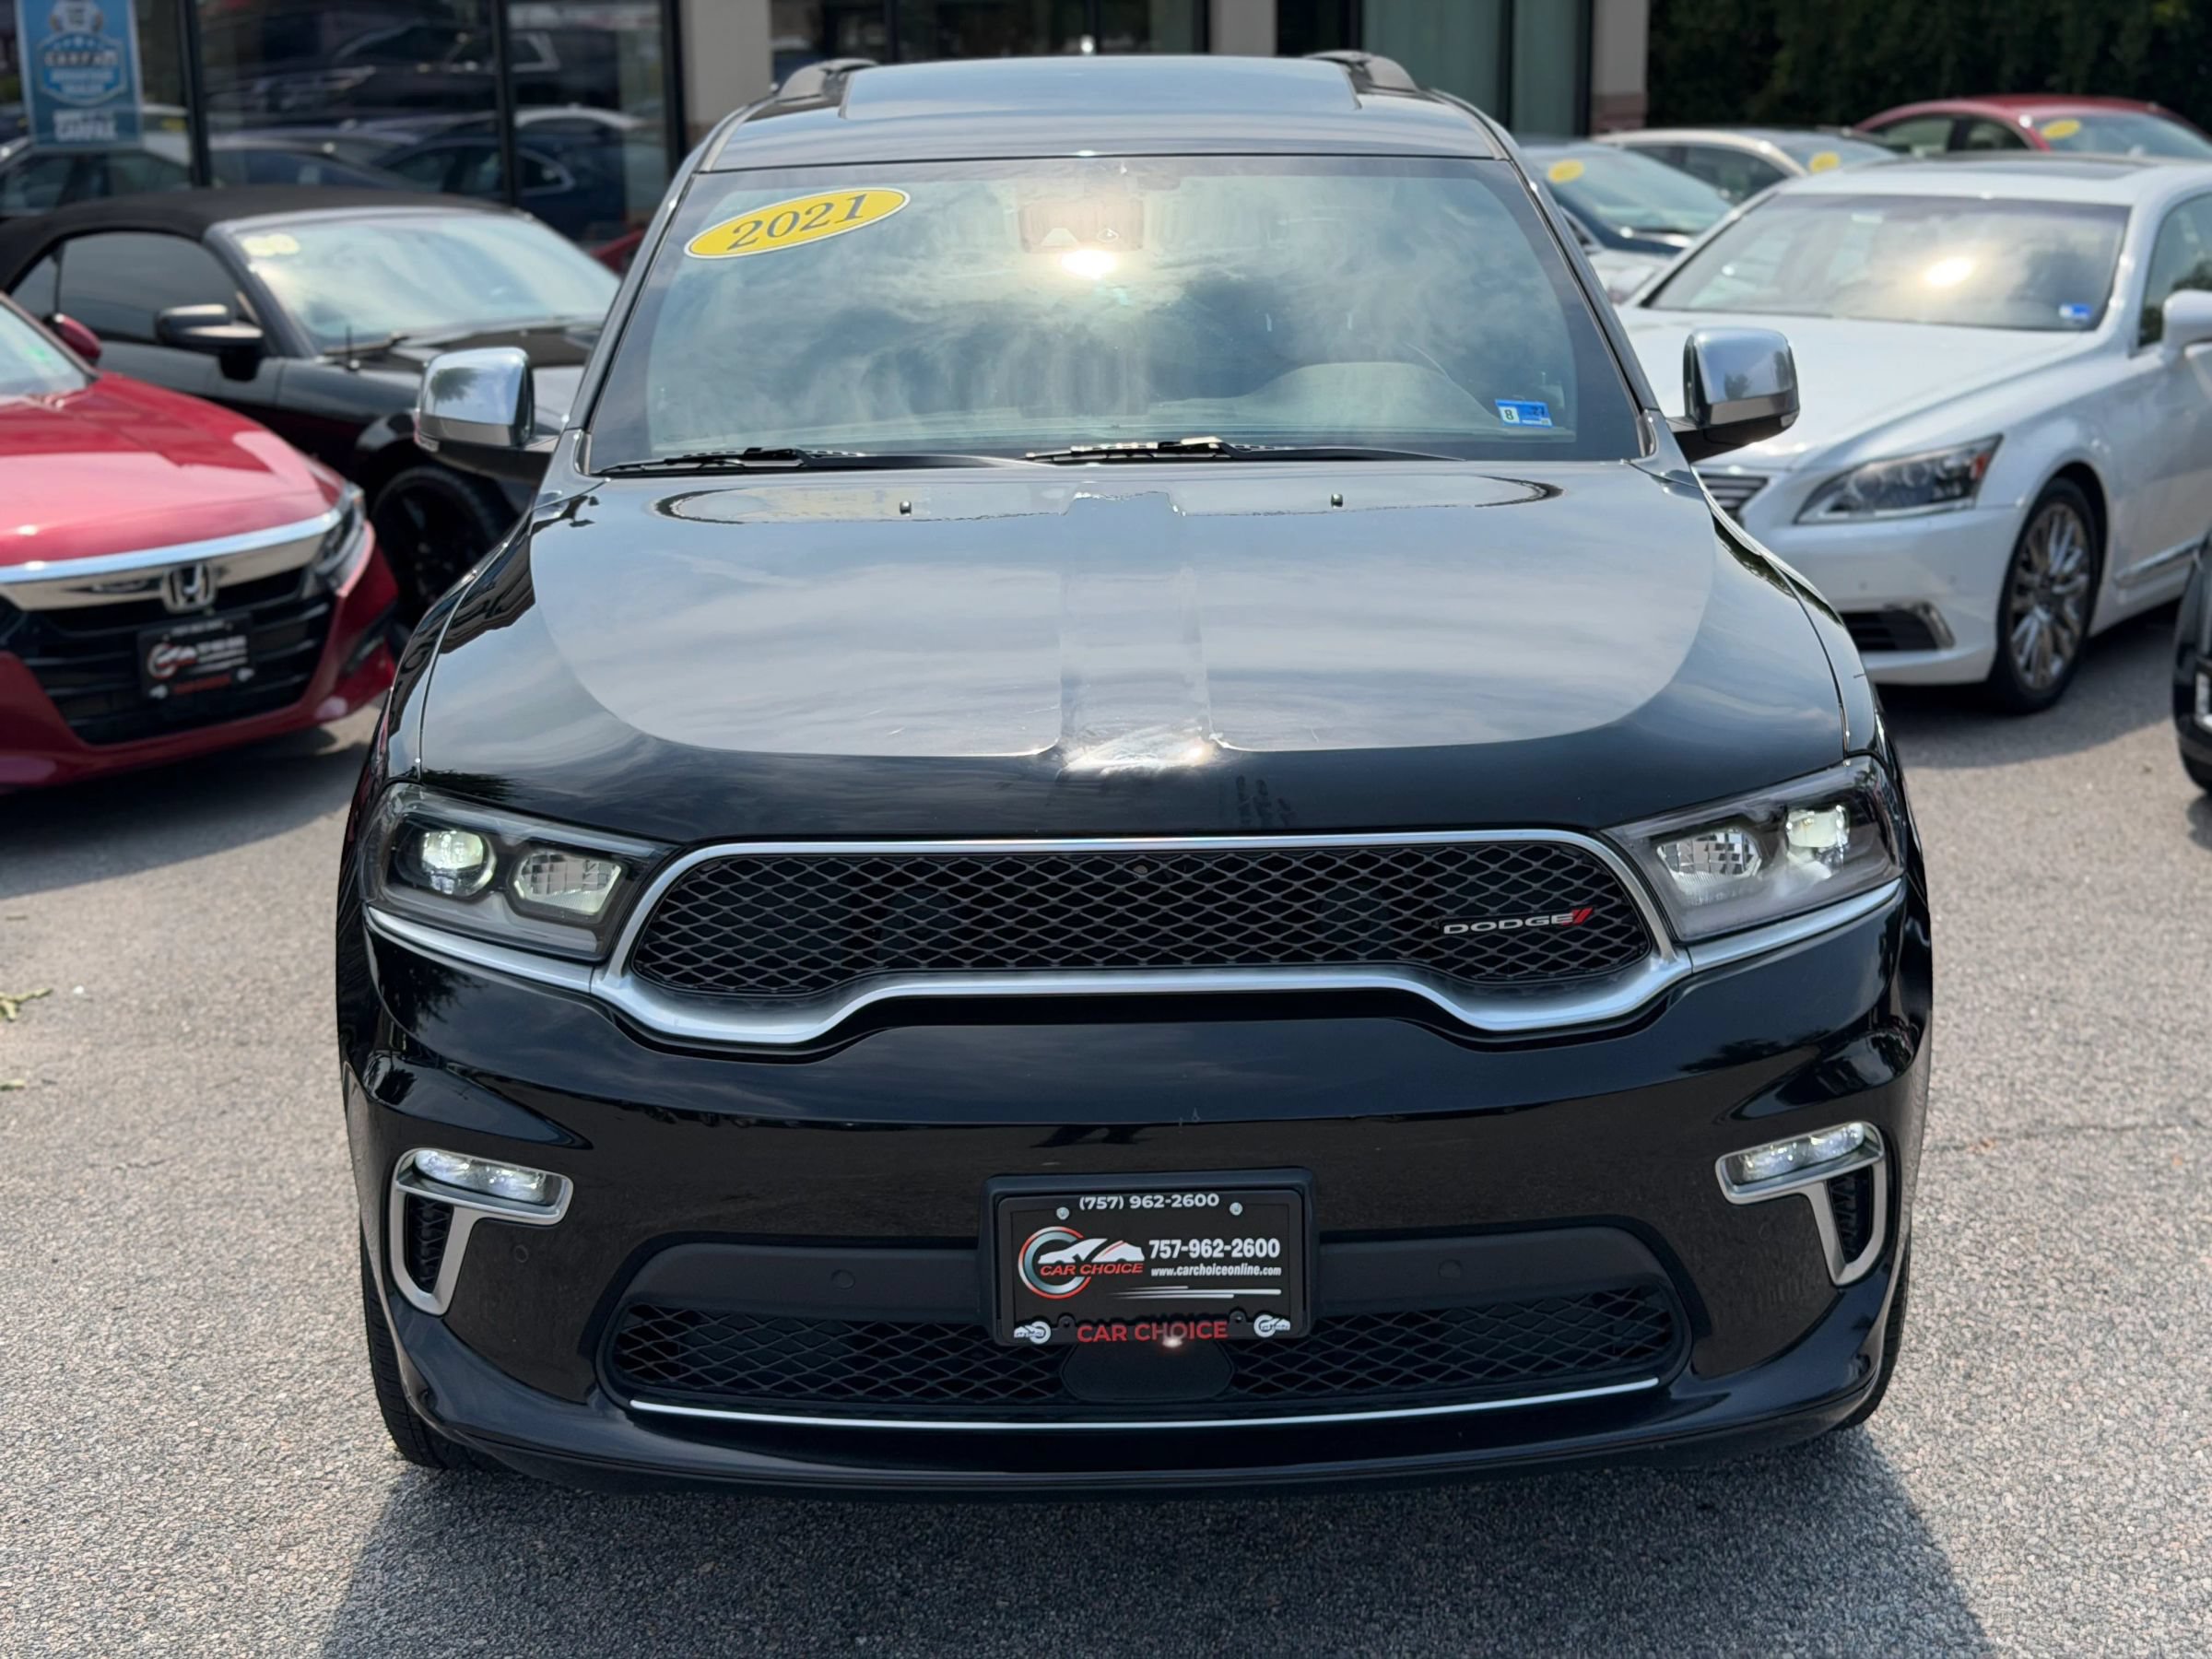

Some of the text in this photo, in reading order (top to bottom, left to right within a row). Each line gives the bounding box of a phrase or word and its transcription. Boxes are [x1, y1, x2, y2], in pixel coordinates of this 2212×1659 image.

[726, 193, 869, 252] 2021
[1504, 408, 1514, 421] 8
[1443, 912, 1574, 935] DODGE
[1078, 1193, 1220, 1210] (757) 962-2600
[1148, 1238, 1281, 1259] 757-962-2600
[1040, 1263, 1144, 1277] CAR CHOICE
[1150, 1263, 1282, 1277] www.carchoiceonline.com
[1077, 1321, 1229, 1343] CAR CHOICE
